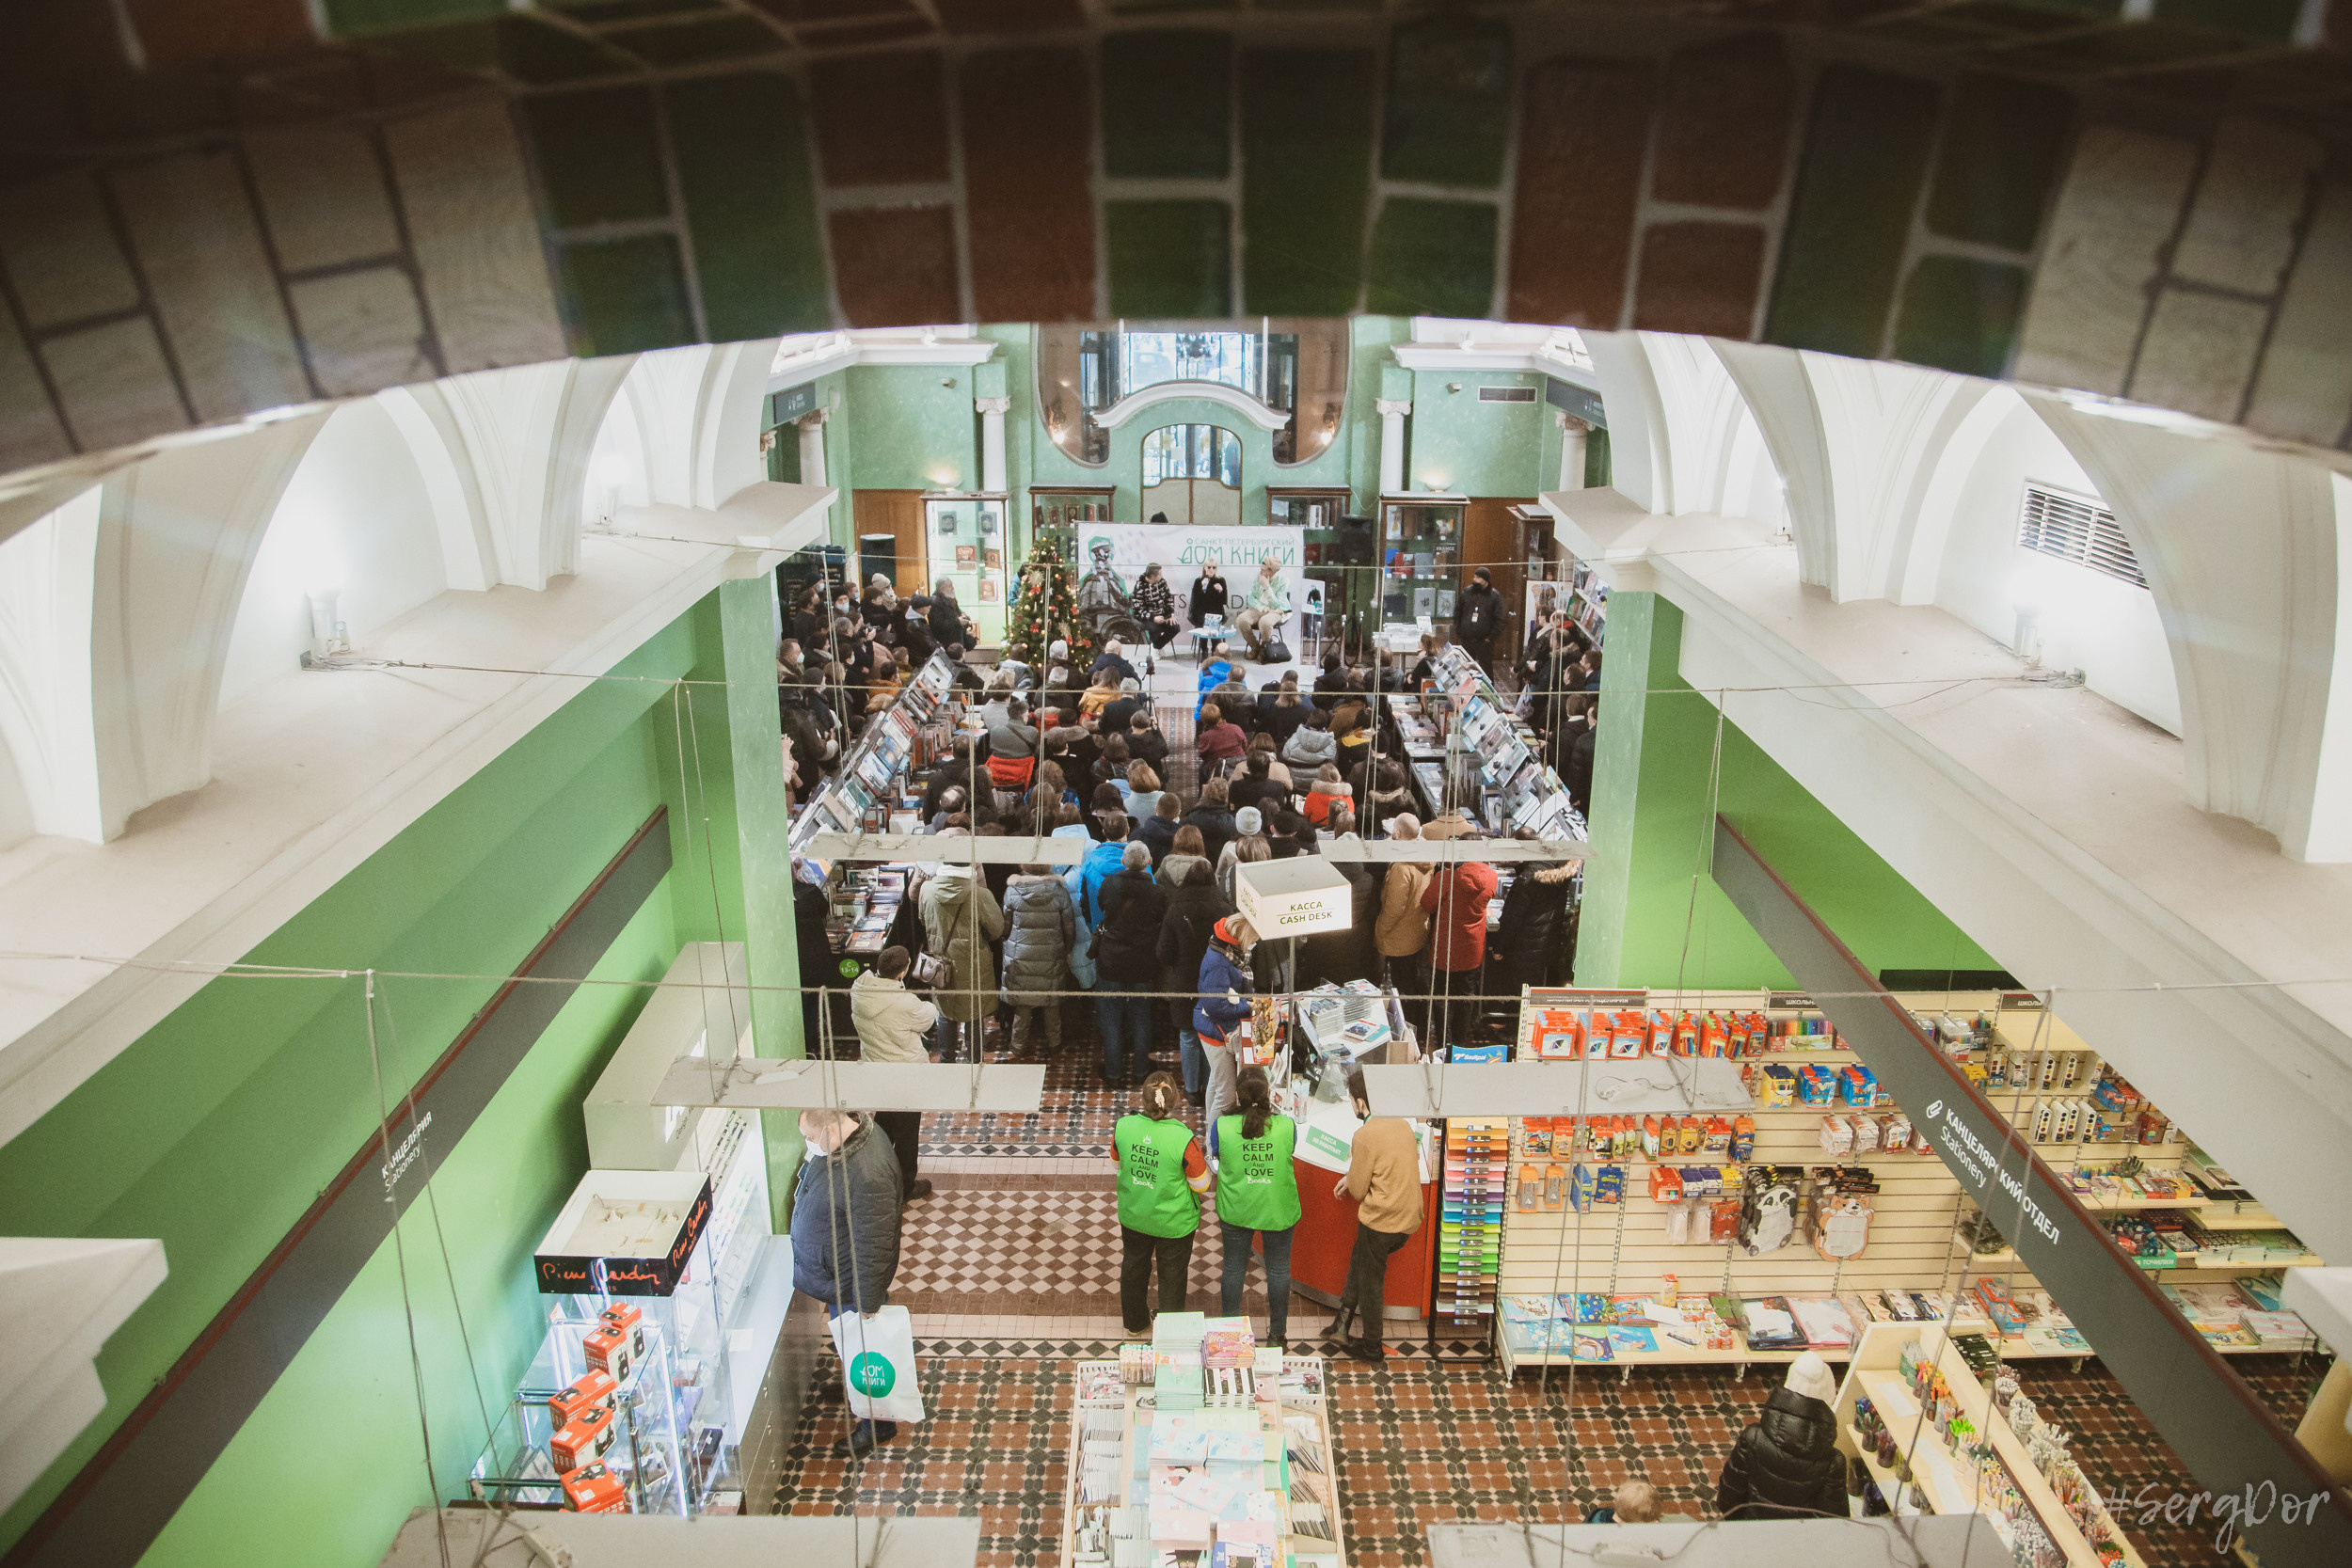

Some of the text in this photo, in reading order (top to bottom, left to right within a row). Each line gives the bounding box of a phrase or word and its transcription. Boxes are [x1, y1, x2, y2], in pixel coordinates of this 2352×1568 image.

[1196, 537, 1295, 546] САНКТ-ПЕТЕРБУРГСКИЙ
[1177, 546, 1294, 564] ДОМ КНИГИ
[1290, 900, 1323, 911] КАССА
[1279, 911, 1333, 925] CASH DESK
[1131, 1143, 1160, 1157] KEEP
[1243, 1143, 1274, 1151] KEEP
[1131, 1154, 1159, 1168] CALM
[1243, 1153, 1274, 1162] CALM
[1940, 1125, 1987, 1189] Stationery
[1131, 1168, 1157, 1182] LOVE
[1248, 1176, 1272, 1184] Books
[1132, 1177, 1154, 1190] Books
[2023, 1196, 2060, 1245] ОТДЕЛ
